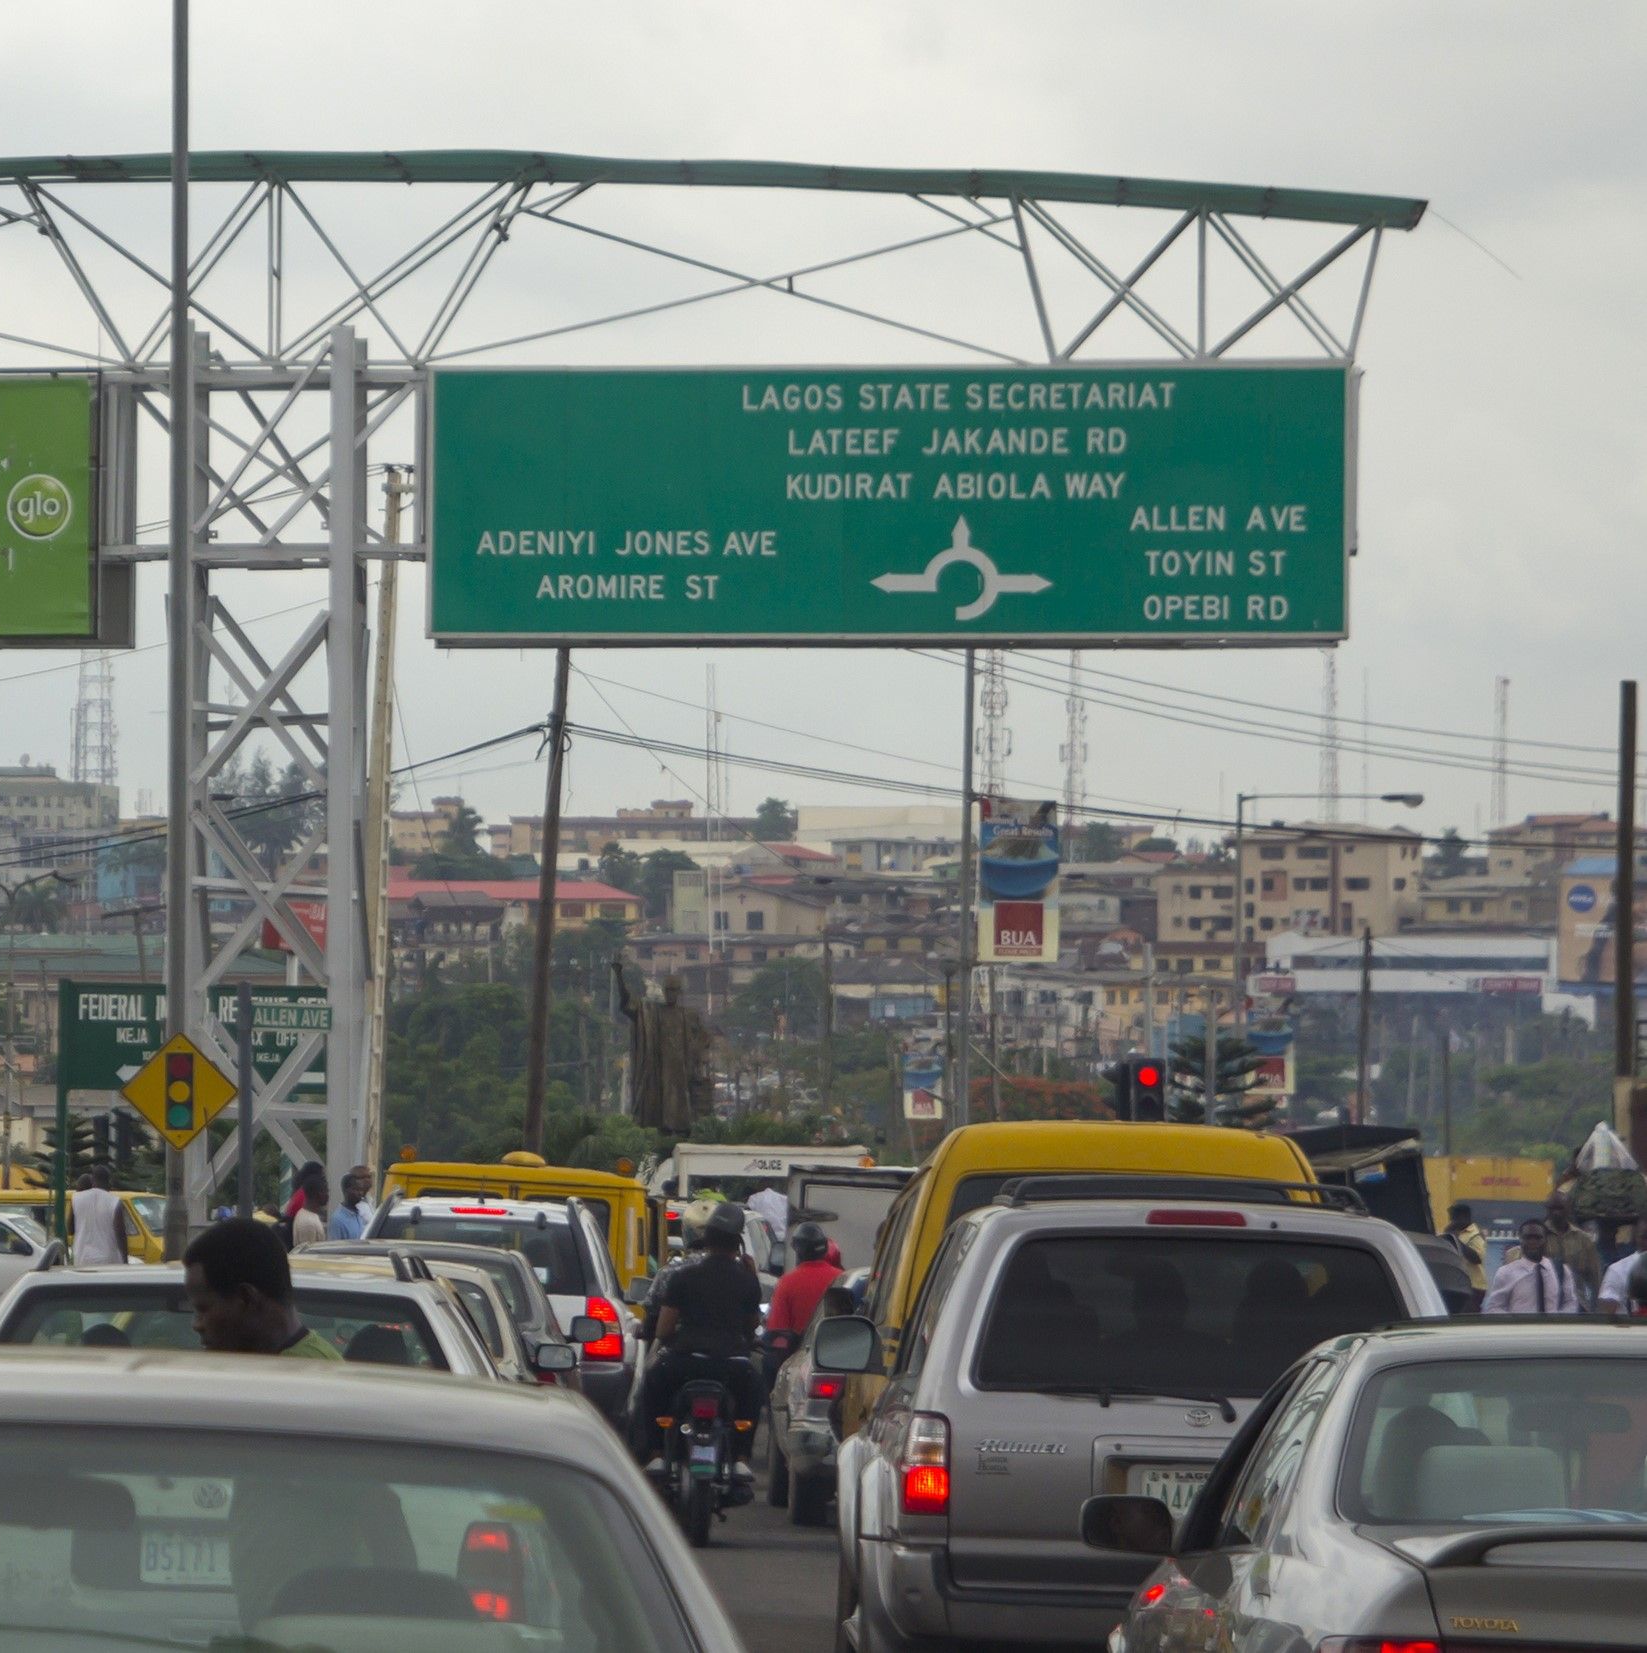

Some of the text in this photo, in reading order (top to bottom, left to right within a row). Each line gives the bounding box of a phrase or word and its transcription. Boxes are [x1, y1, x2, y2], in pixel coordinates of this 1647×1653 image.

[743, 381, 1175, 412] LAGOS STATE SECRETARIAT
[788, 428, 1127, 456] LATEEF JAKANDE RD
[786, 472, 1126, 501] KUDIRAT ABIOLA WAY
[17, 491, 60, 523] glo
[1130, 506, 1307, 534] ALLEN AVE
[477, 530, 777, 557] ADENIYI JONES AVE
[1146, 550, 1286, 577] TOYIN ST
[537, 574, 718, 601] AROMIRE ST
[1143, 595, 1289, 623] OPEBI RD
[1000, 930, 1037, 945] BUA
[79, 993, 147, 1021] FEDERAL
[254, 1007, 297, 1027] ALLEN
[300, 1009, 328, 1028] AVE
[116, 1027, 148, 1043] IKEJA
[1450, 1616, 1520, 1633] TOYOTA
